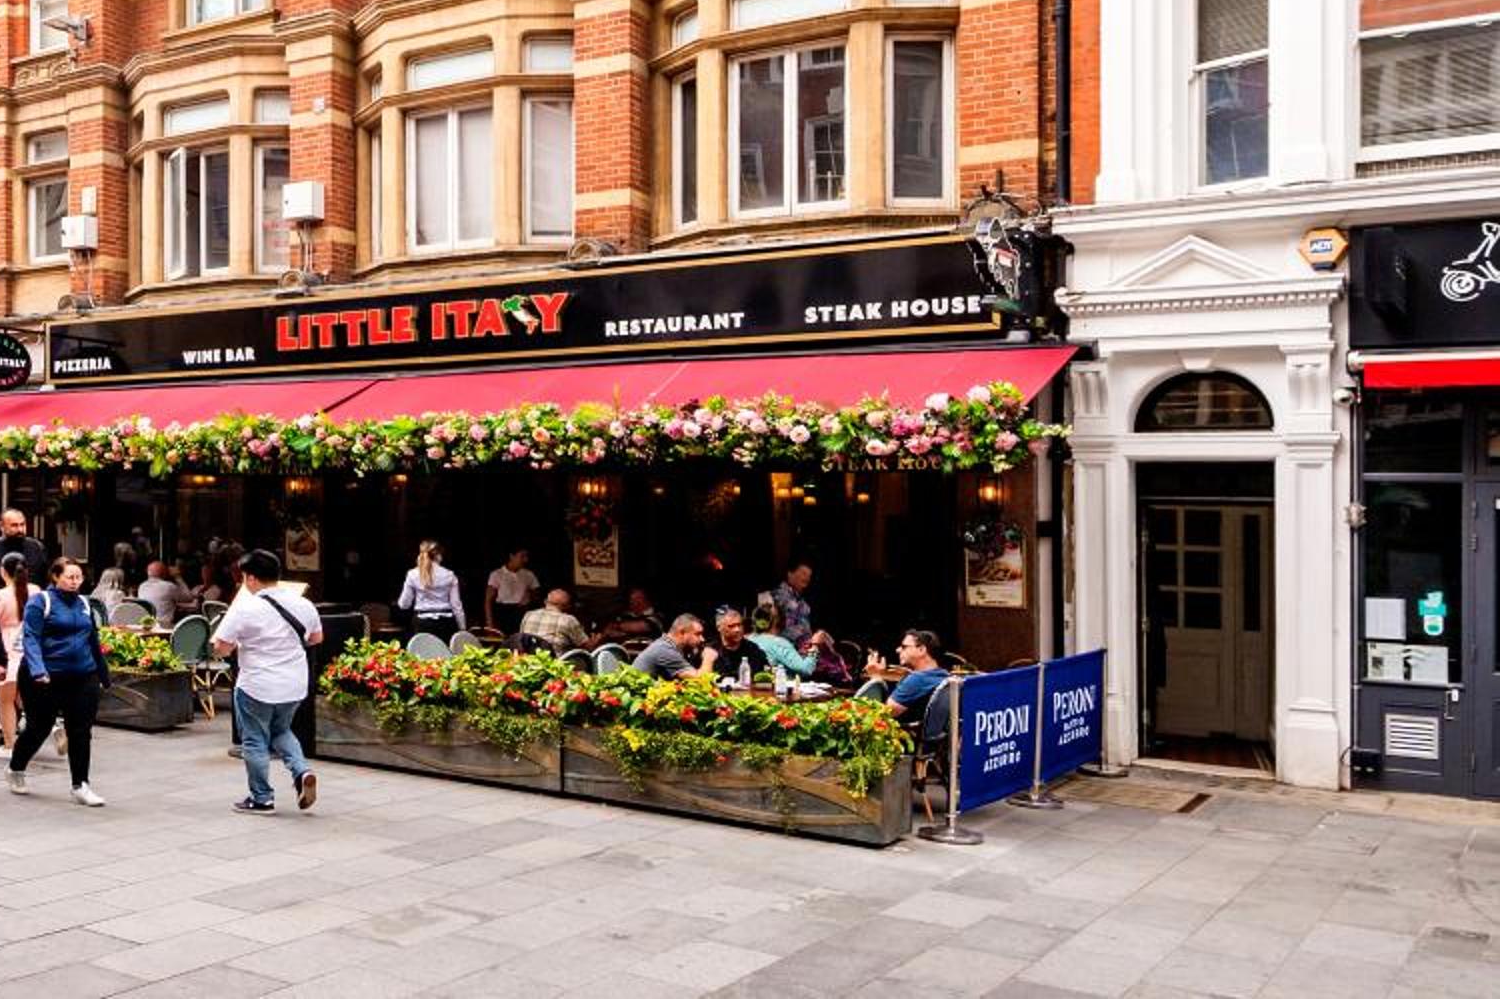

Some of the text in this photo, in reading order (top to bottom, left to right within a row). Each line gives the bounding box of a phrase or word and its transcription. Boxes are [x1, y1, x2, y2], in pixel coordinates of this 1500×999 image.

[804, 295, 981, 324] STEAK HOUSE
[276, 305, 417, 351] LITTLE
[605, 312, 745, 337] RESTAURANT
[0, 357, 26, 368] ITALY
[54, 356, 112, 374] PIZZERIA
[182, 346, 255, 365] WINE BAR
[1053, 685, 1096, 724] PERONI
[974, 704, 1030, 746] PERONI
